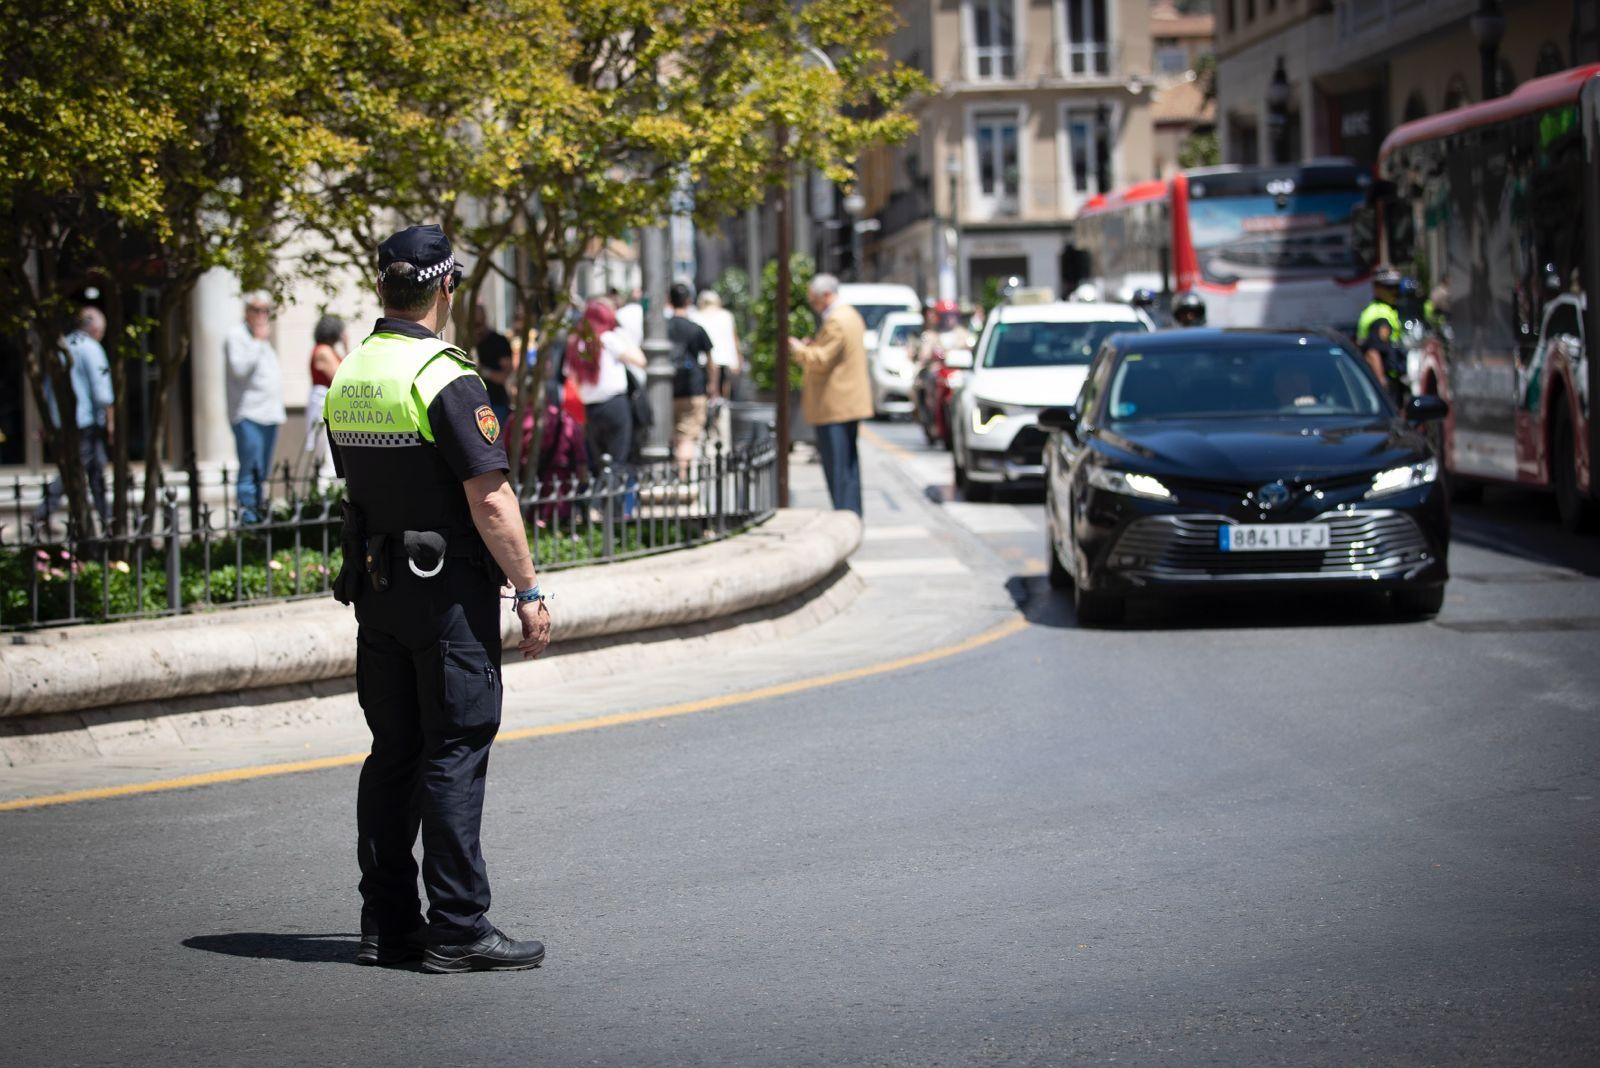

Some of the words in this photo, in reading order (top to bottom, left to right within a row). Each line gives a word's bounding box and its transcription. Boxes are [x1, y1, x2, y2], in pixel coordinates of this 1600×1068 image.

[341, 384, 383, 399] POLICIA
[350, 400, 372, 409] LOCAL
[333, 410, 396, 424] GRANADA
[1234, 528, 1280, 547] 8841
[1288, 527, 1326, 545] LFJ
